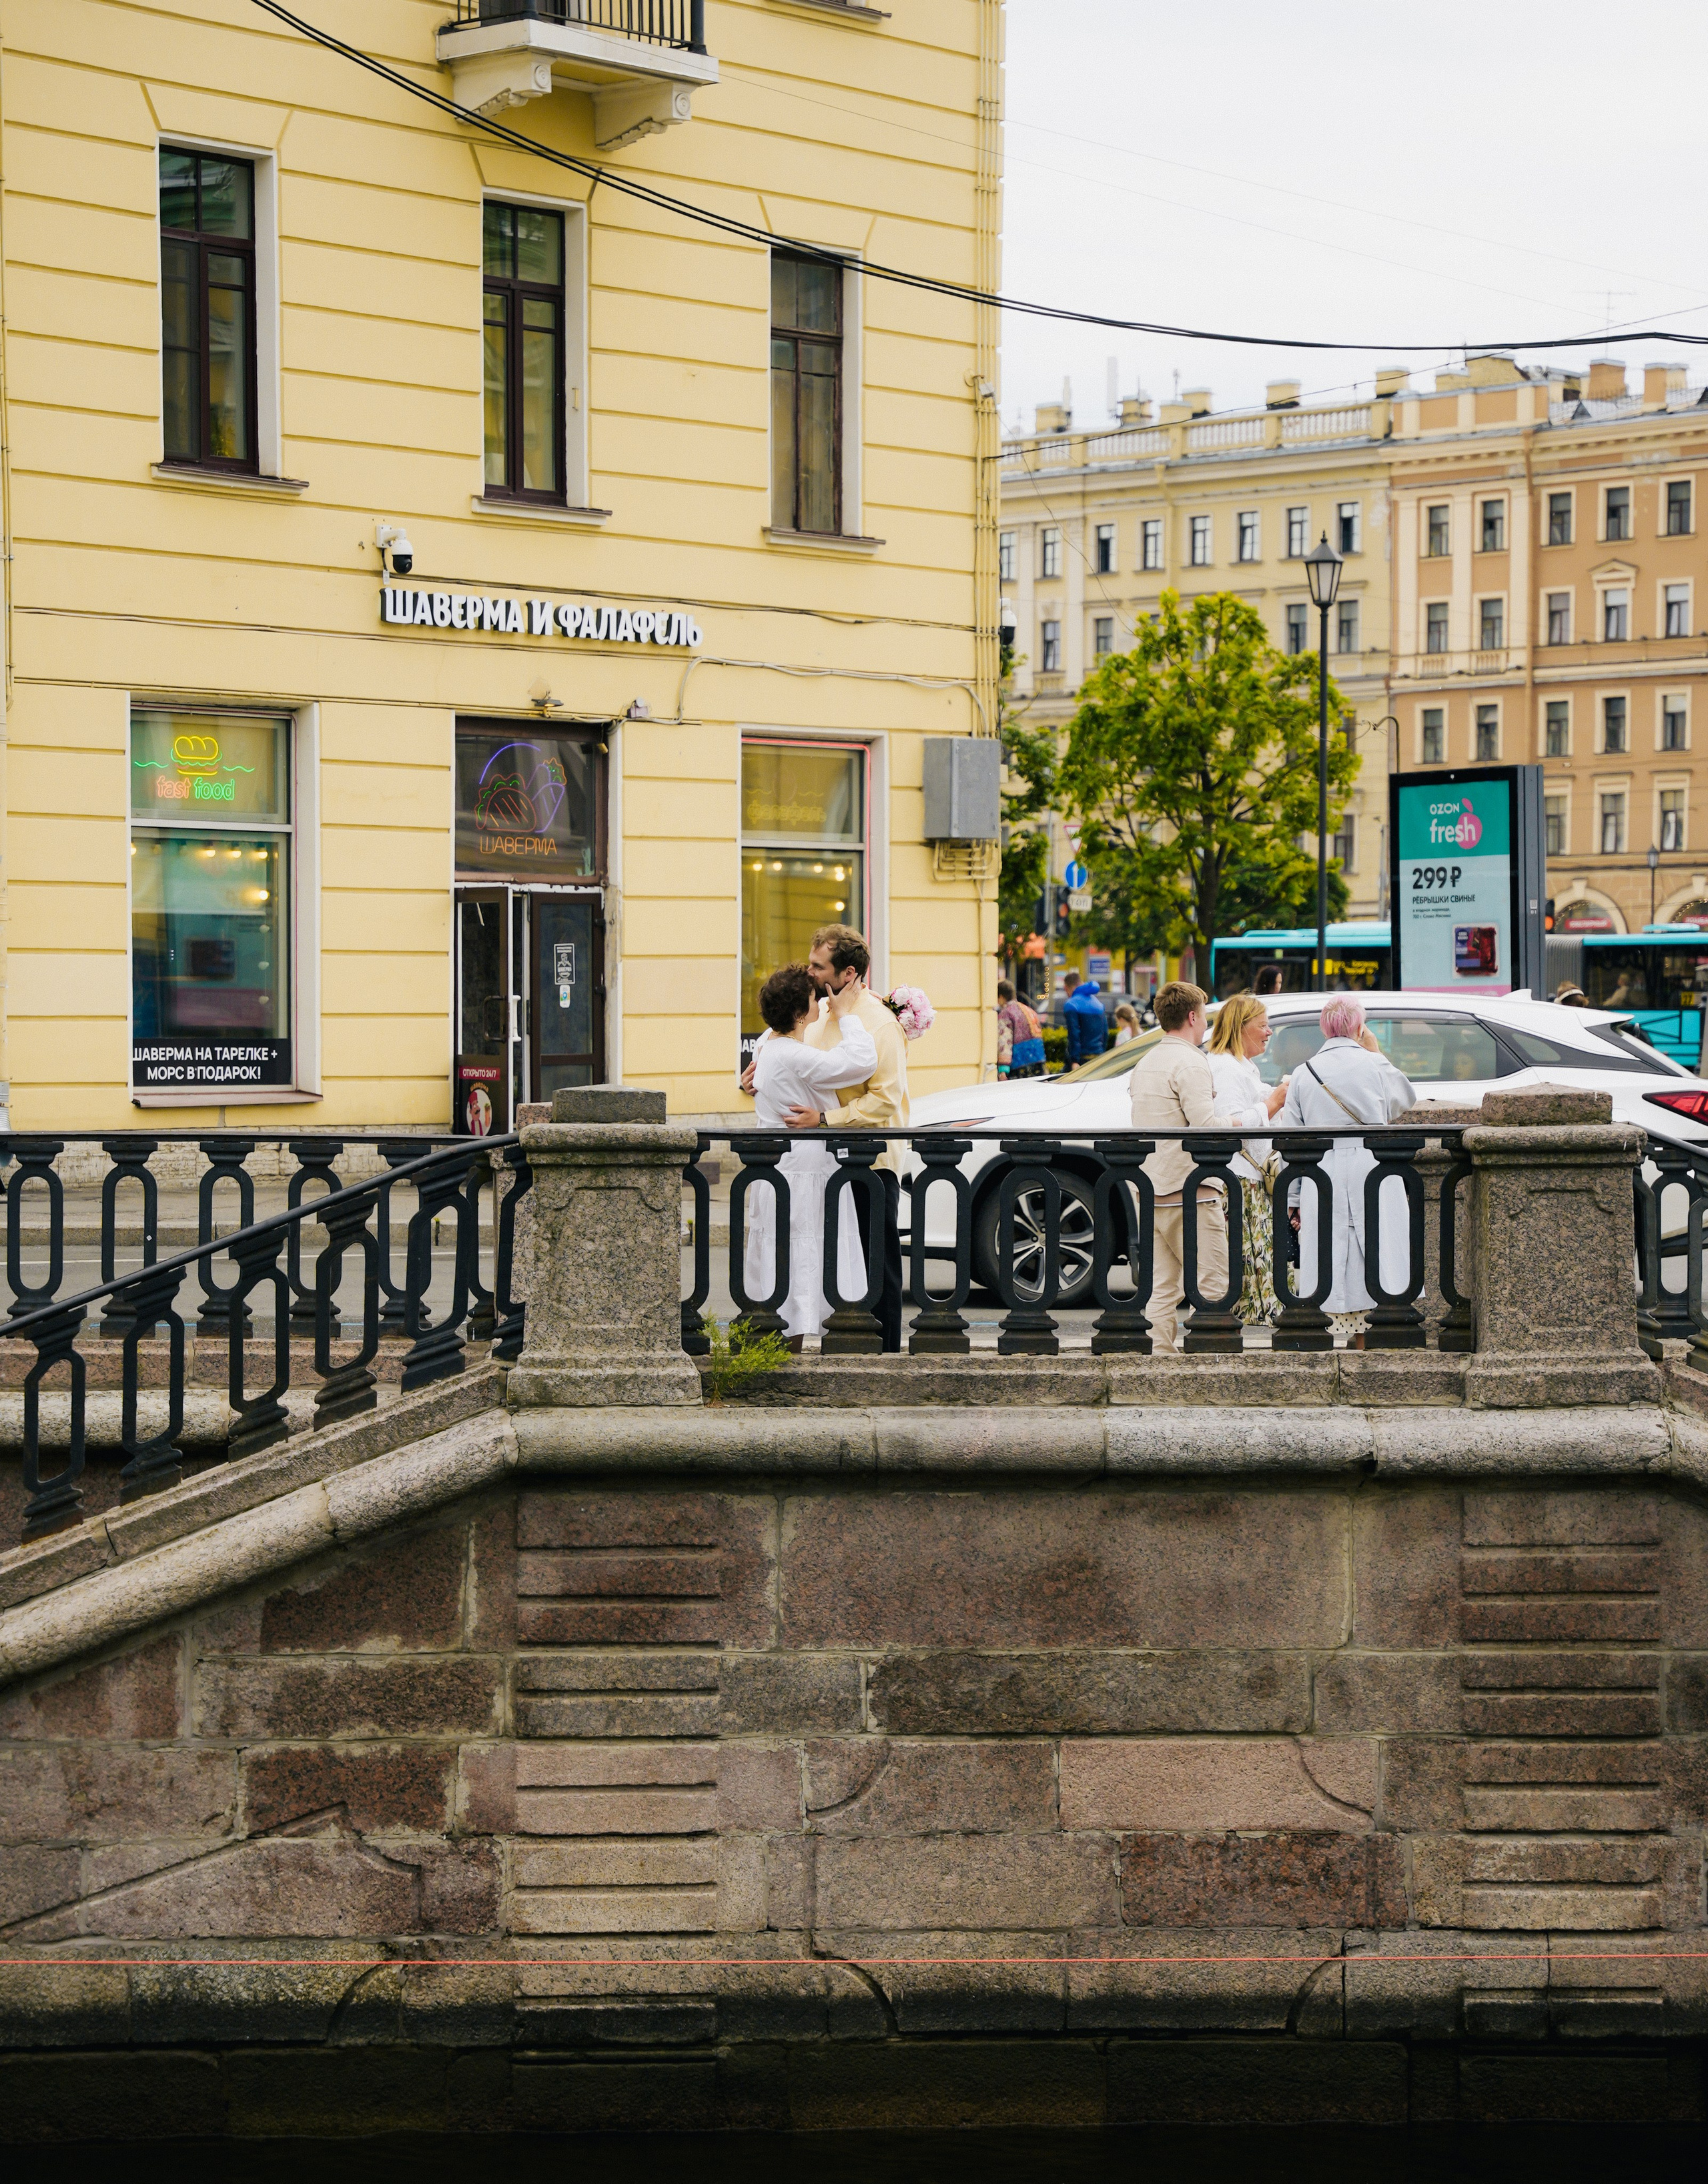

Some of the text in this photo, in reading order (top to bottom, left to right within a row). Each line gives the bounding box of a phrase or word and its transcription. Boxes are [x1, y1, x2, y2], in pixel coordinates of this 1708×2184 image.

[380, 588, 703, 647] ШАВЕРМА И ФАЛАФЕЛЬ
[157, 776, 235, 800] fast food
[1429, 802, 1460, 815] OZON
[1429, 816, 1476, 843] fresh
[480, 836, 558, 856] ШАВЕРМА
[1412, 895, 1475, 904] РЁБРЫШКИ СВИНЫЕ
[133, 1047, 193, 1061] ШАВЕРМА
[195, 1047, 213, 1061] НА
[214, 1047, 269, 1061] ТАРЕЛКЕ
[147, 1066, 261, 1082] МОРС В ПОДАРОК!
[462, 1068, 497, 1078] ОТКРЫТО 24/7
